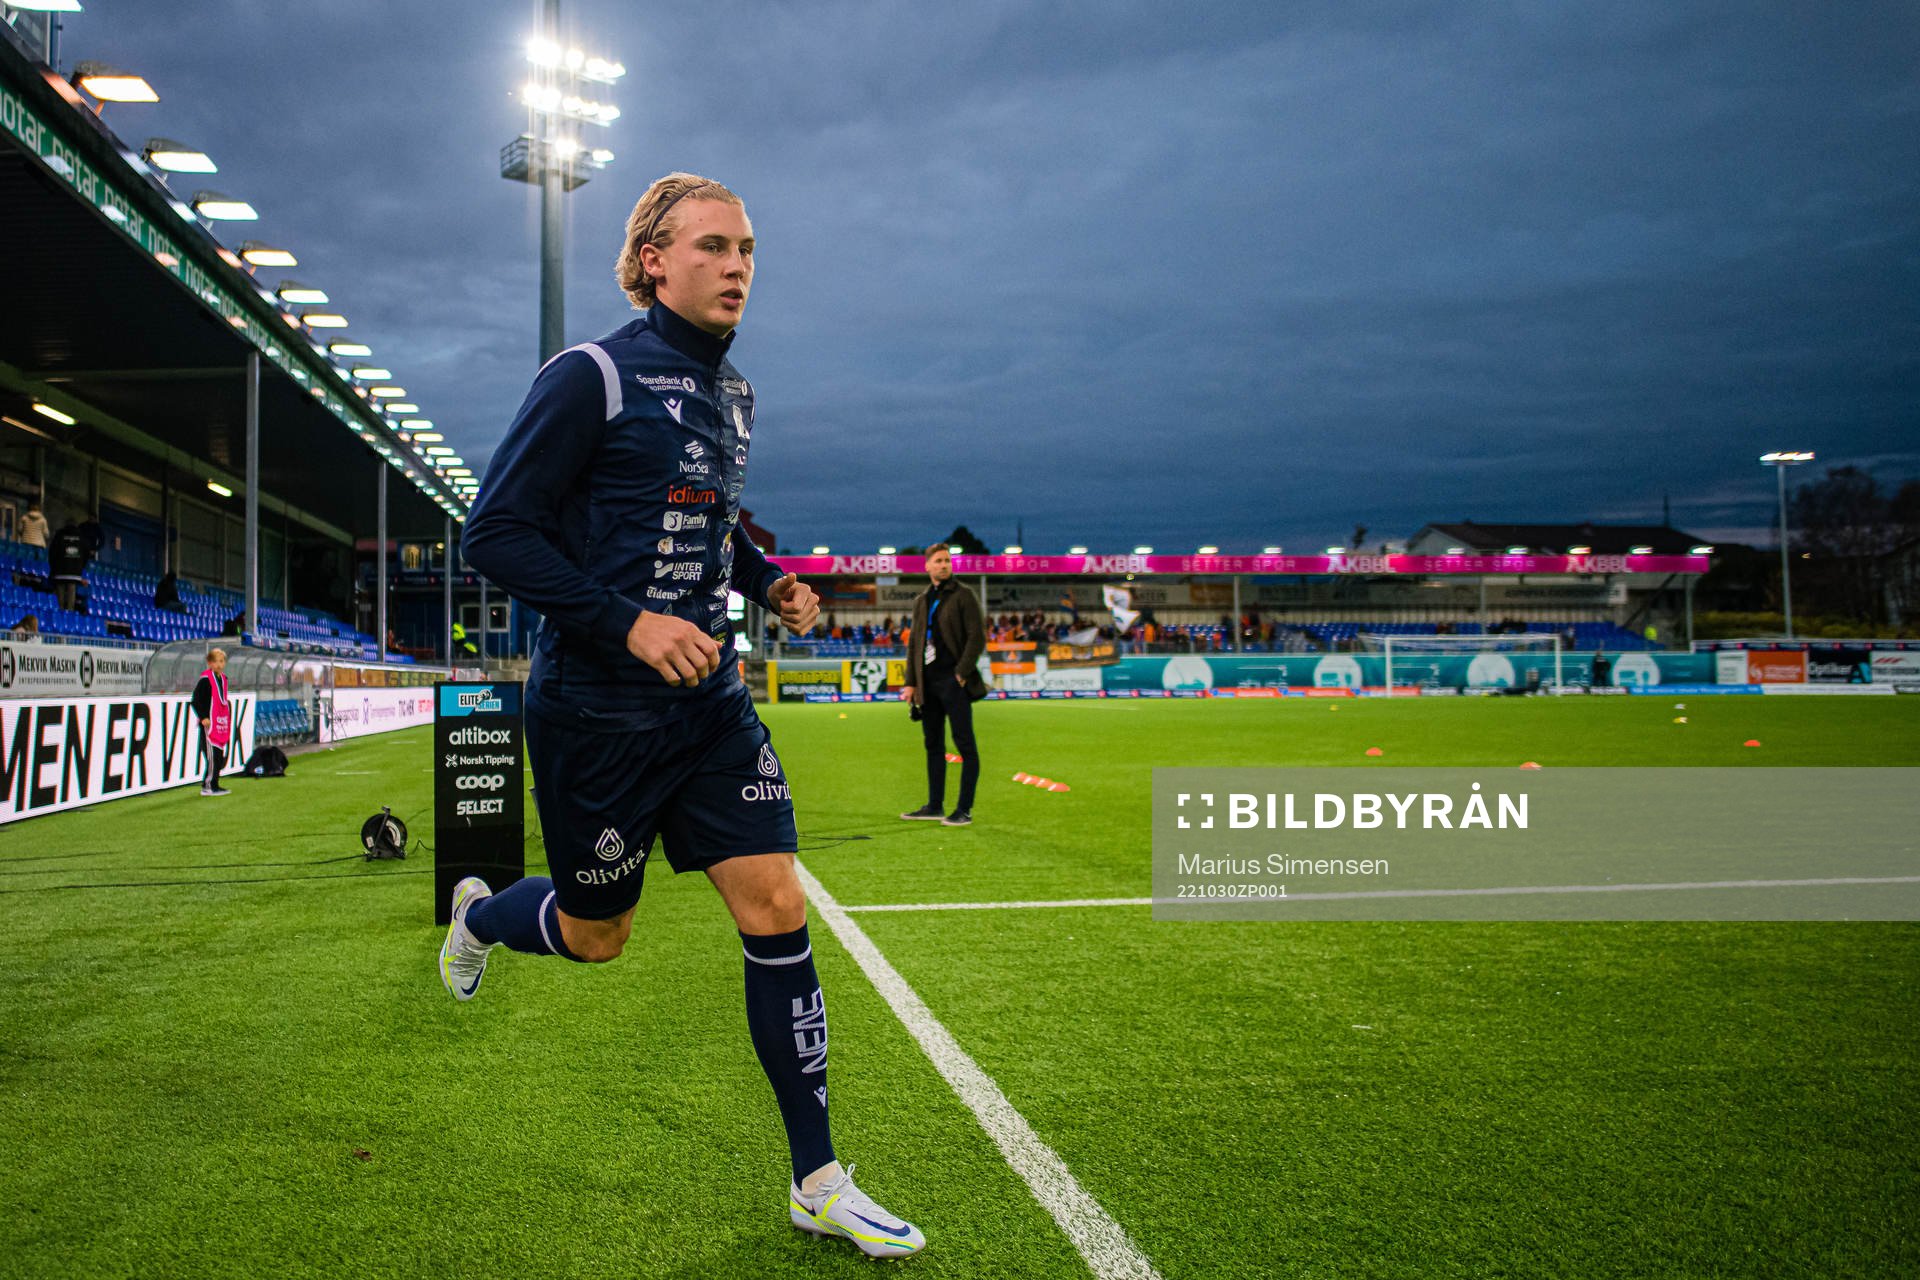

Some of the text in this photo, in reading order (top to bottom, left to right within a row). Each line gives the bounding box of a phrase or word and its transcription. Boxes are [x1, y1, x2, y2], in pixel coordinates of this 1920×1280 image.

[636, 374, 682, 386] SpareBank
[679, 461, 709, 474] NorSea
[668, 484, 716, 504] idium
[682, 513, 708, 529] Family
[674, 562, 704, 572] INTER
[1004, 558, 1050, 572] SPOR
[671, 571, 703, 581] SPORT
[646, 586, 679, 600] Tidens
[18, 655, 77, 673] MEKVIK MASKIN
[96, 659, 143, 675] MEKVIK MASKIN
[460, 694, 479, 706] ELITE
[476, 700, 500, 711] SERIEN
[449, 727, 511, 746] altibox
[102, 702, 150, 796] ER
[161, 701, 192, 784] VI
[459, 754, 515, 766] Norsk Tipping
[455, 774, 505, 791] coop
[741, 780, 792, 802] olivit
[456, 798, 504, 816] SELECT
